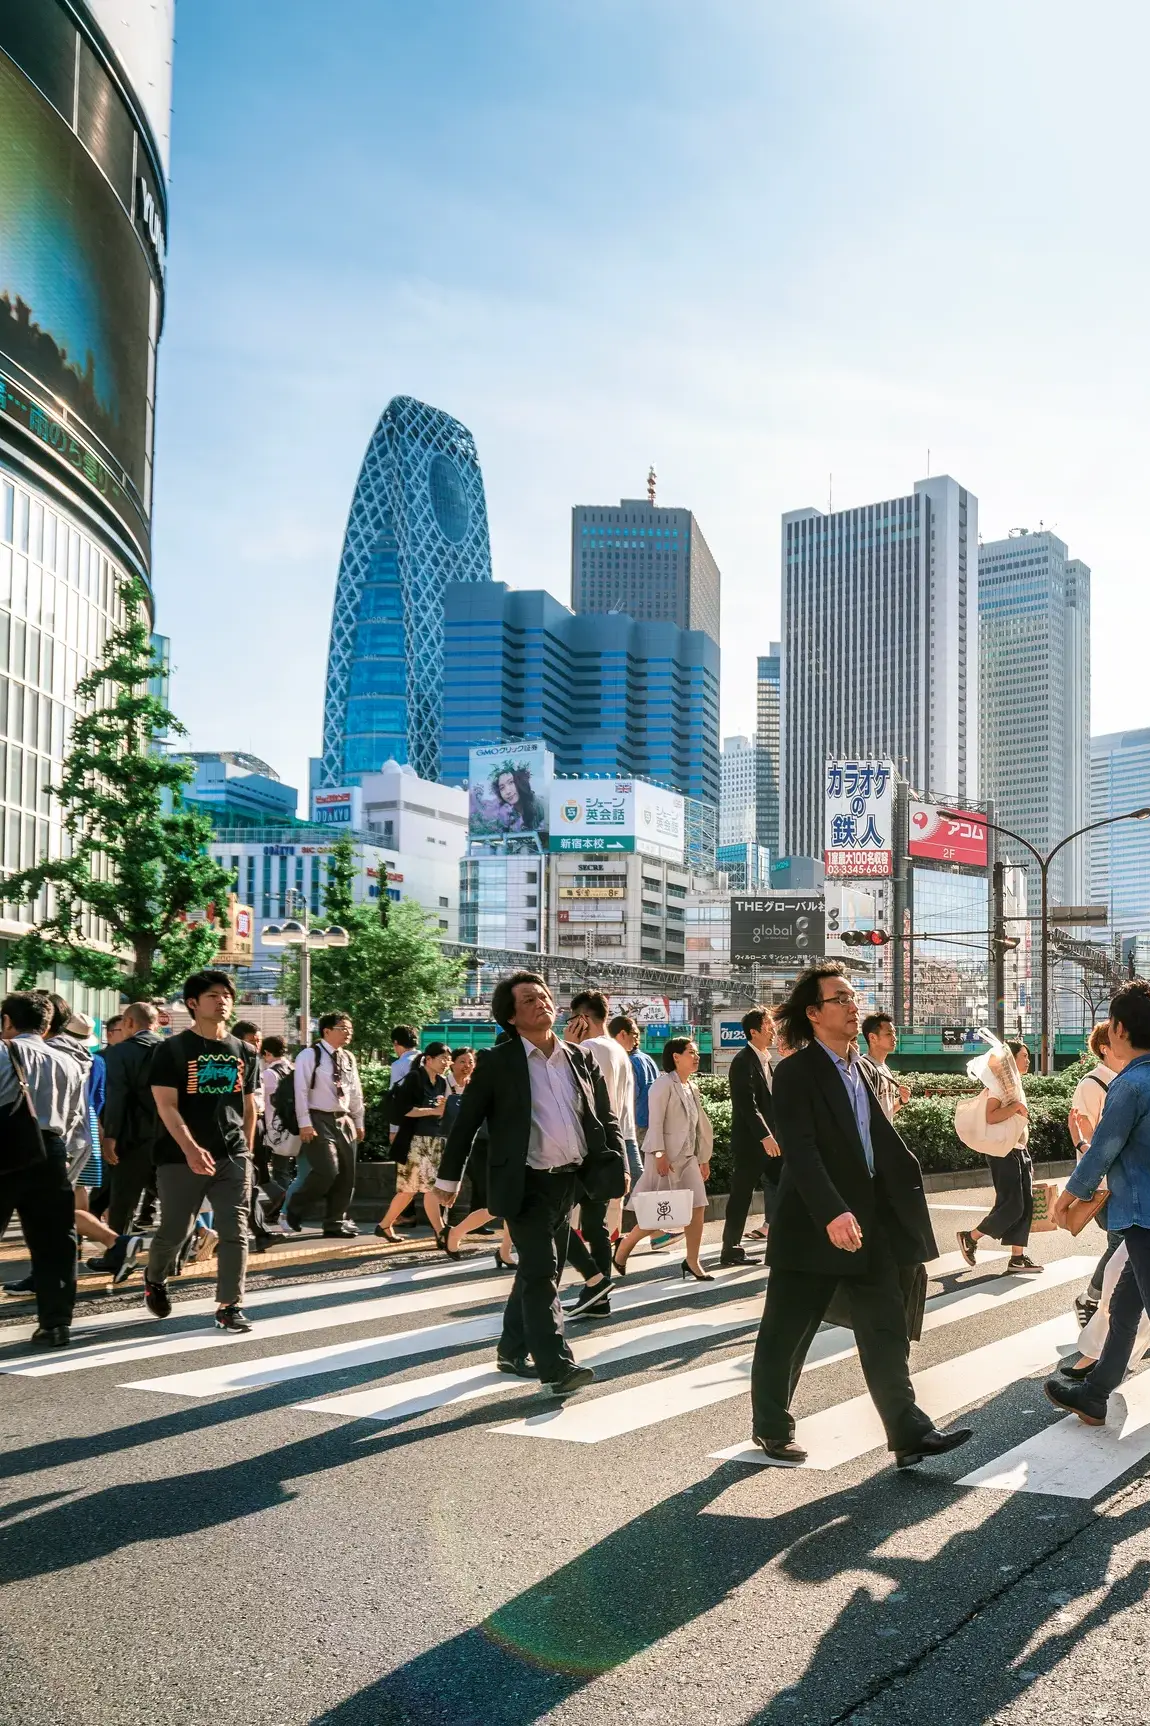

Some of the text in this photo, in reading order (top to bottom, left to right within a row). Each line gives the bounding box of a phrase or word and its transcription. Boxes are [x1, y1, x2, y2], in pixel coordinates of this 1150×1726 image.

[476, 744, 538, 756] GMOクリック証券
[827, 761, 891, 799] カラオケ
[585, 797, 626, 808] シェーン
[850, 794, 867, 818] の
[585, 808, 625, 821] 英会話
[831, 814, 885, 849] 鉄人
[947, 821, 984, 840] アコム
[560, 838, 604, 849] 新宿本校
[943, 848, 956, 859] 2F
[828, 865, 889, 874] 03-3345-6430
[608, 889, 619, 897] 8F
[753, 924, 792, 943] global
